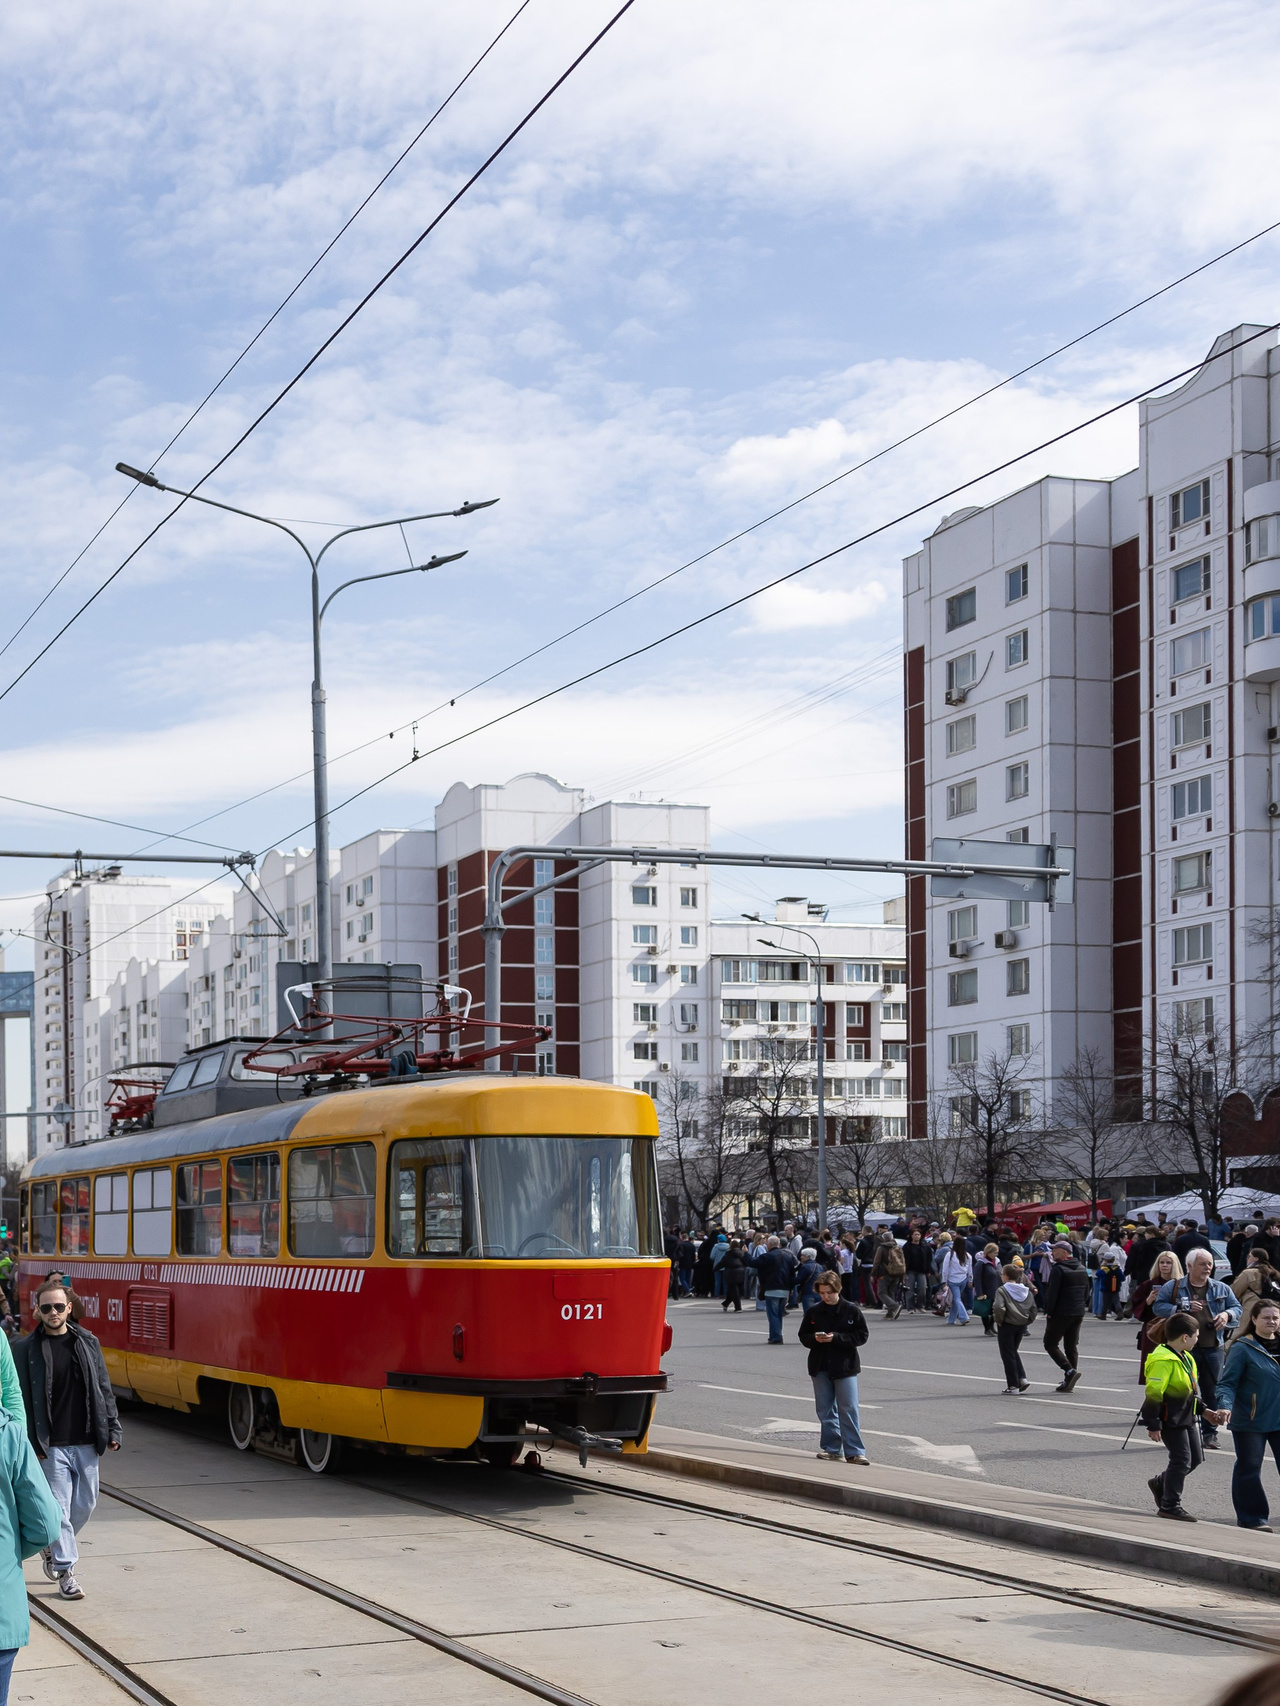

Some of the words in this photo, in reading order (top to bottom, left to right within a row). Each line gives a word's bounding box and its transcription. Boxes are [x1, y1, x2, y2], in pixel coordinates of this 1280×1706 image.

[144, 1264, 158, 1280] 0121
[107, 1298, 123, 1322] СЕТИ
[561, 1304, 602, 1320] 0121
